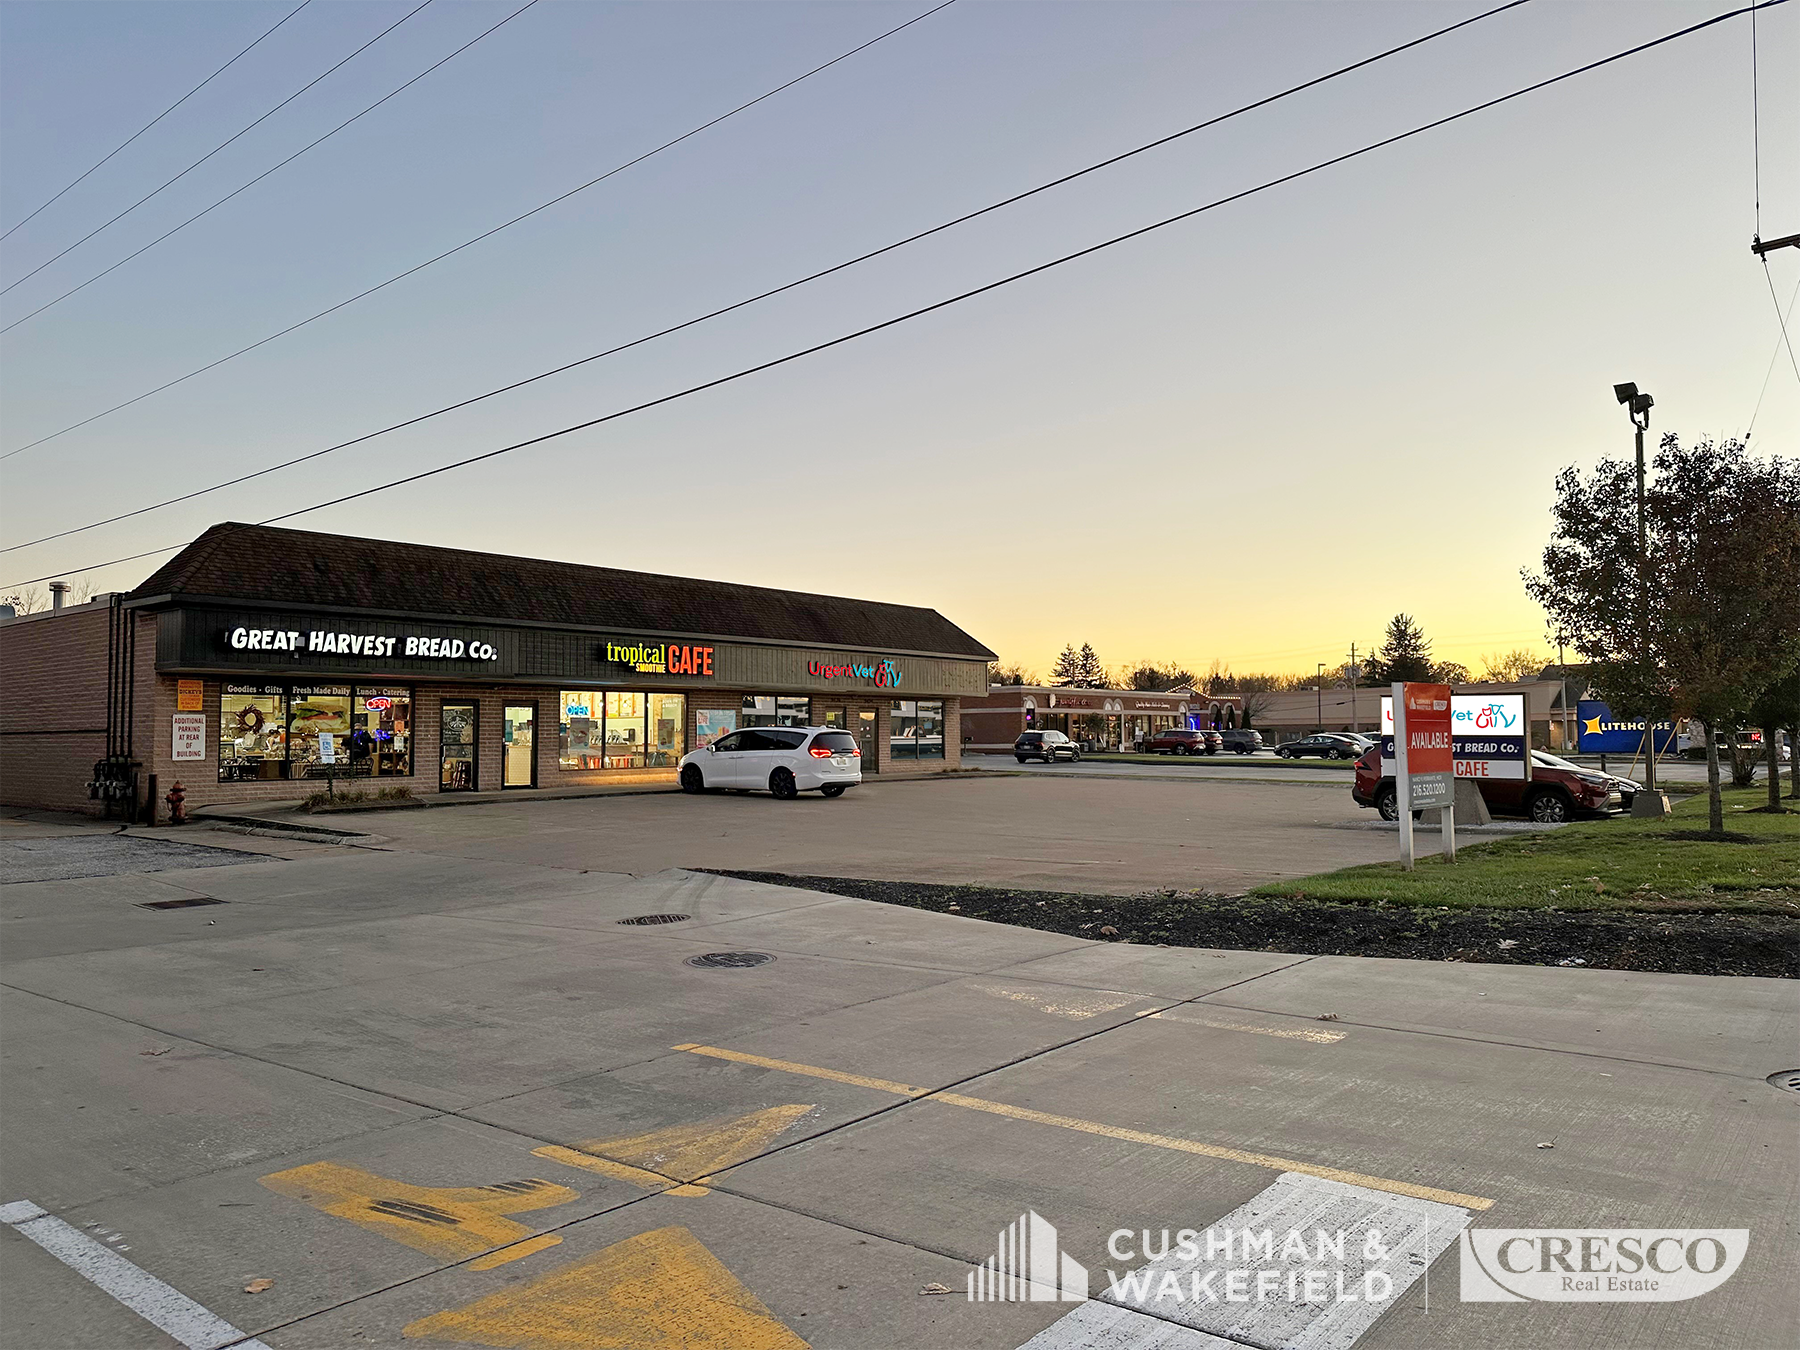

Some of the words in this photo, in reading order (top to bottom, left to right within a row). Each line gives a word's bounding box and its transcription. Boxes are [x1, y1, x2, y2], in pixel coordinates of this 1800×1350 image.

[231, 627, 299, 651] GREAT
[309, 631, 396, 656] HARVEST
[405, 636, 465, 658] BREAD
[607, 641, 666, 666] tropical
[668, 645, 714, 675] CAFE
[636, 663, 666, 673] SMOOTHIE
[808, 661, 874, 679] UrgentVet
[227, 685, 257, 693] Goodies
[265, 685, 283, 694] Gifts
[292, 686, 312, 694] Fresh
[313, 687, 331, 695] Made
[332, 687, 351, 696] Daily
[356, 688, 377, 696] Lunch
[382, 688, 410, 697] Catering
[366, 699, 392, 708] OPEN
[566, 705, 589, 716] OPEN
[1411, 732, 1448, 749] AVAILABLE
[1464, 743, 1498, 753] BREAD
[1456, 761, 1489, 776] CAFE
[1413, 783, 1446, 796] 216.520.1200
